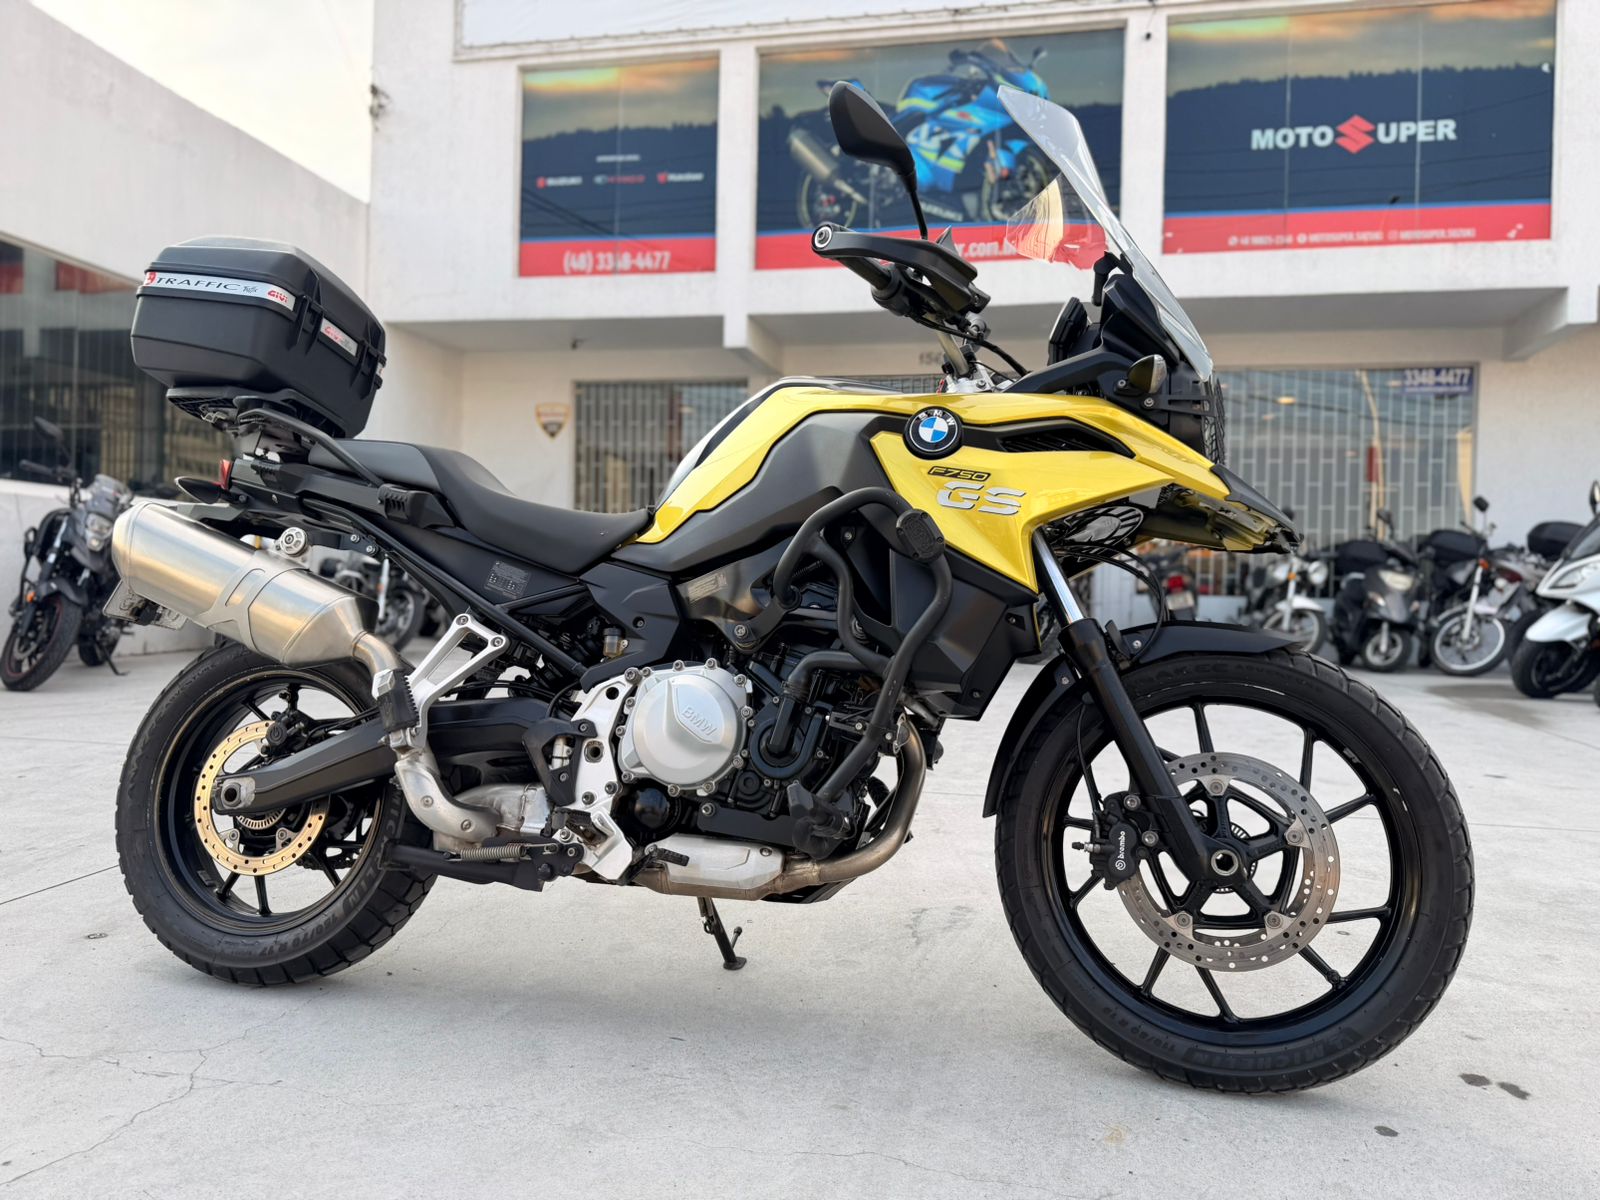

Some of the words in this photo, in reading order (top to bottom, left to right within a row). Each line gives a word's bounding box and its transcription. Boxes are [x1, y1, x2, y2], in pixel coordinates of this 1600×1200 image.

[156, 277, 241, 291] TRAFFIC
[918, 409, 956, 426] BMW
[929, 466, 991, 482] F750
[937, 482, 1026, 515] GS
[683, 706, 718, 735] BMW
[1117, 830, 1127, 859] brembo
